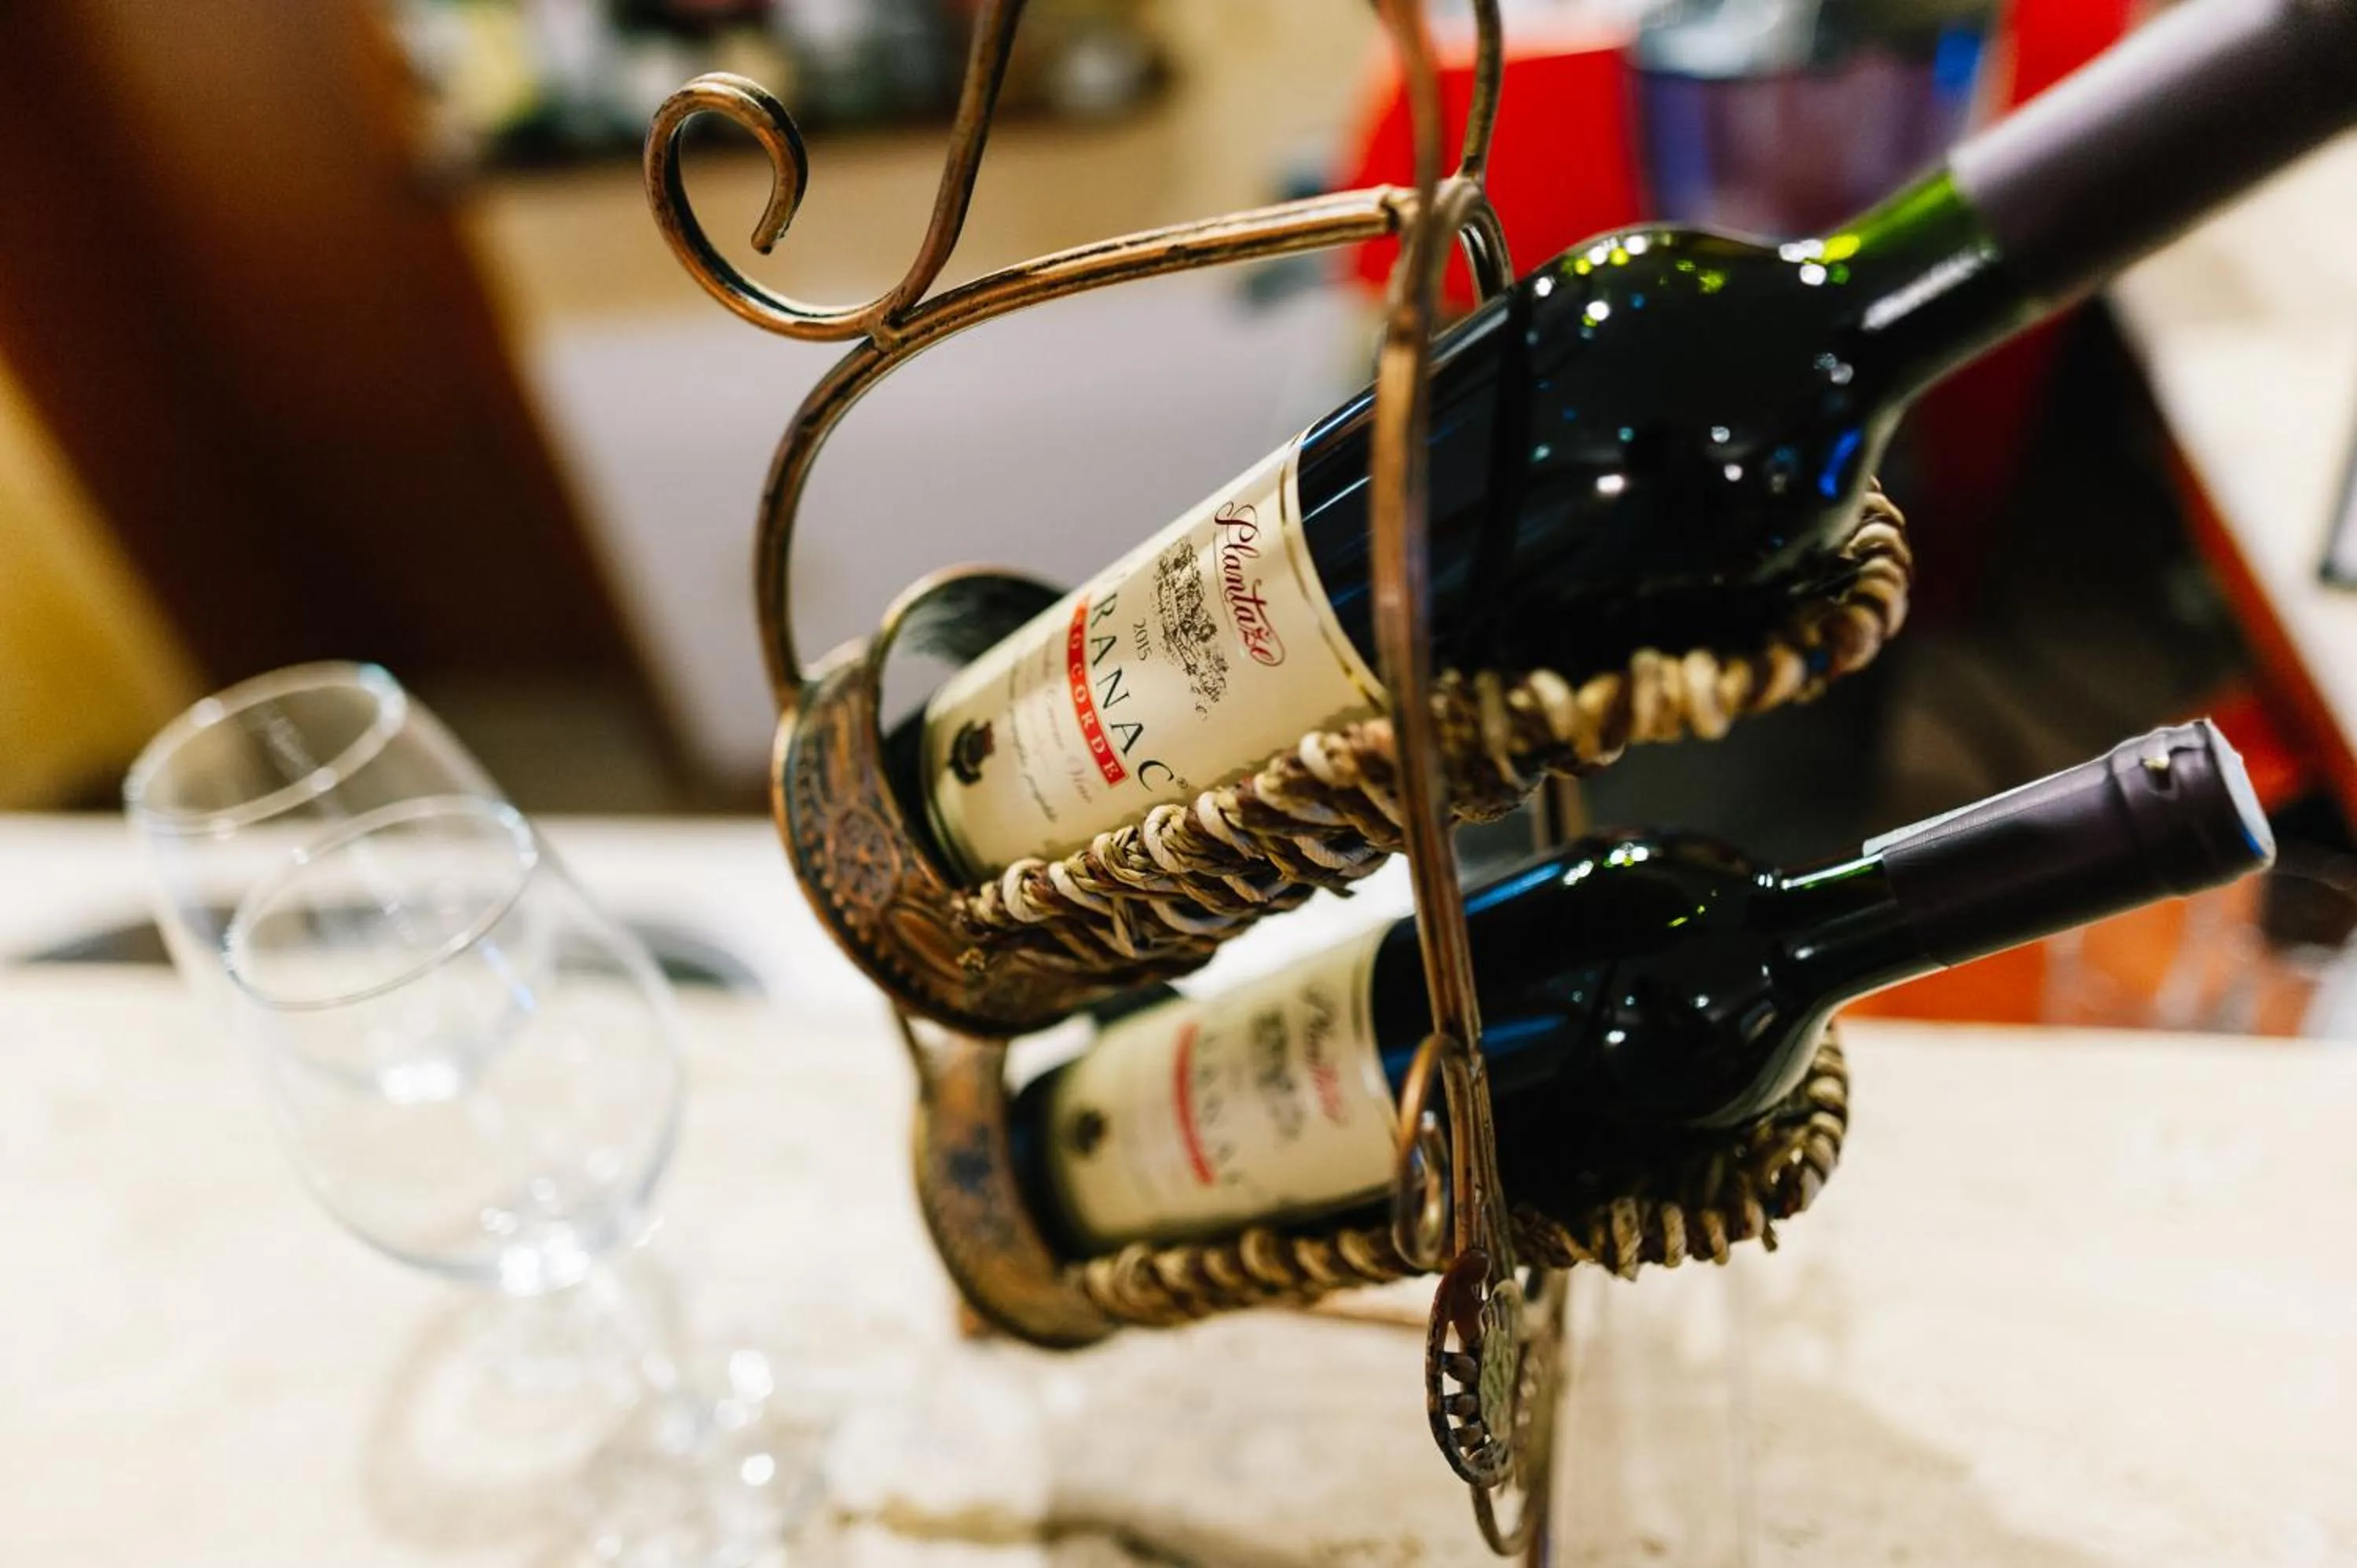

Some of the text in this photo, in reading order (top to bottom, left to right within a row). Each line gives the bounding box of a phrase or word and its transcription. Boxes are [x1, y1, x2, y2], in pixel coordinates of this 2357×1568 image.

[1133, 617, 1153, 661] 2015
[1214, 501, 1285, 666] Plantaže
[1070, 662, 1120, 779] CORDE
[1090, 581, 1175, 793] RANAC
